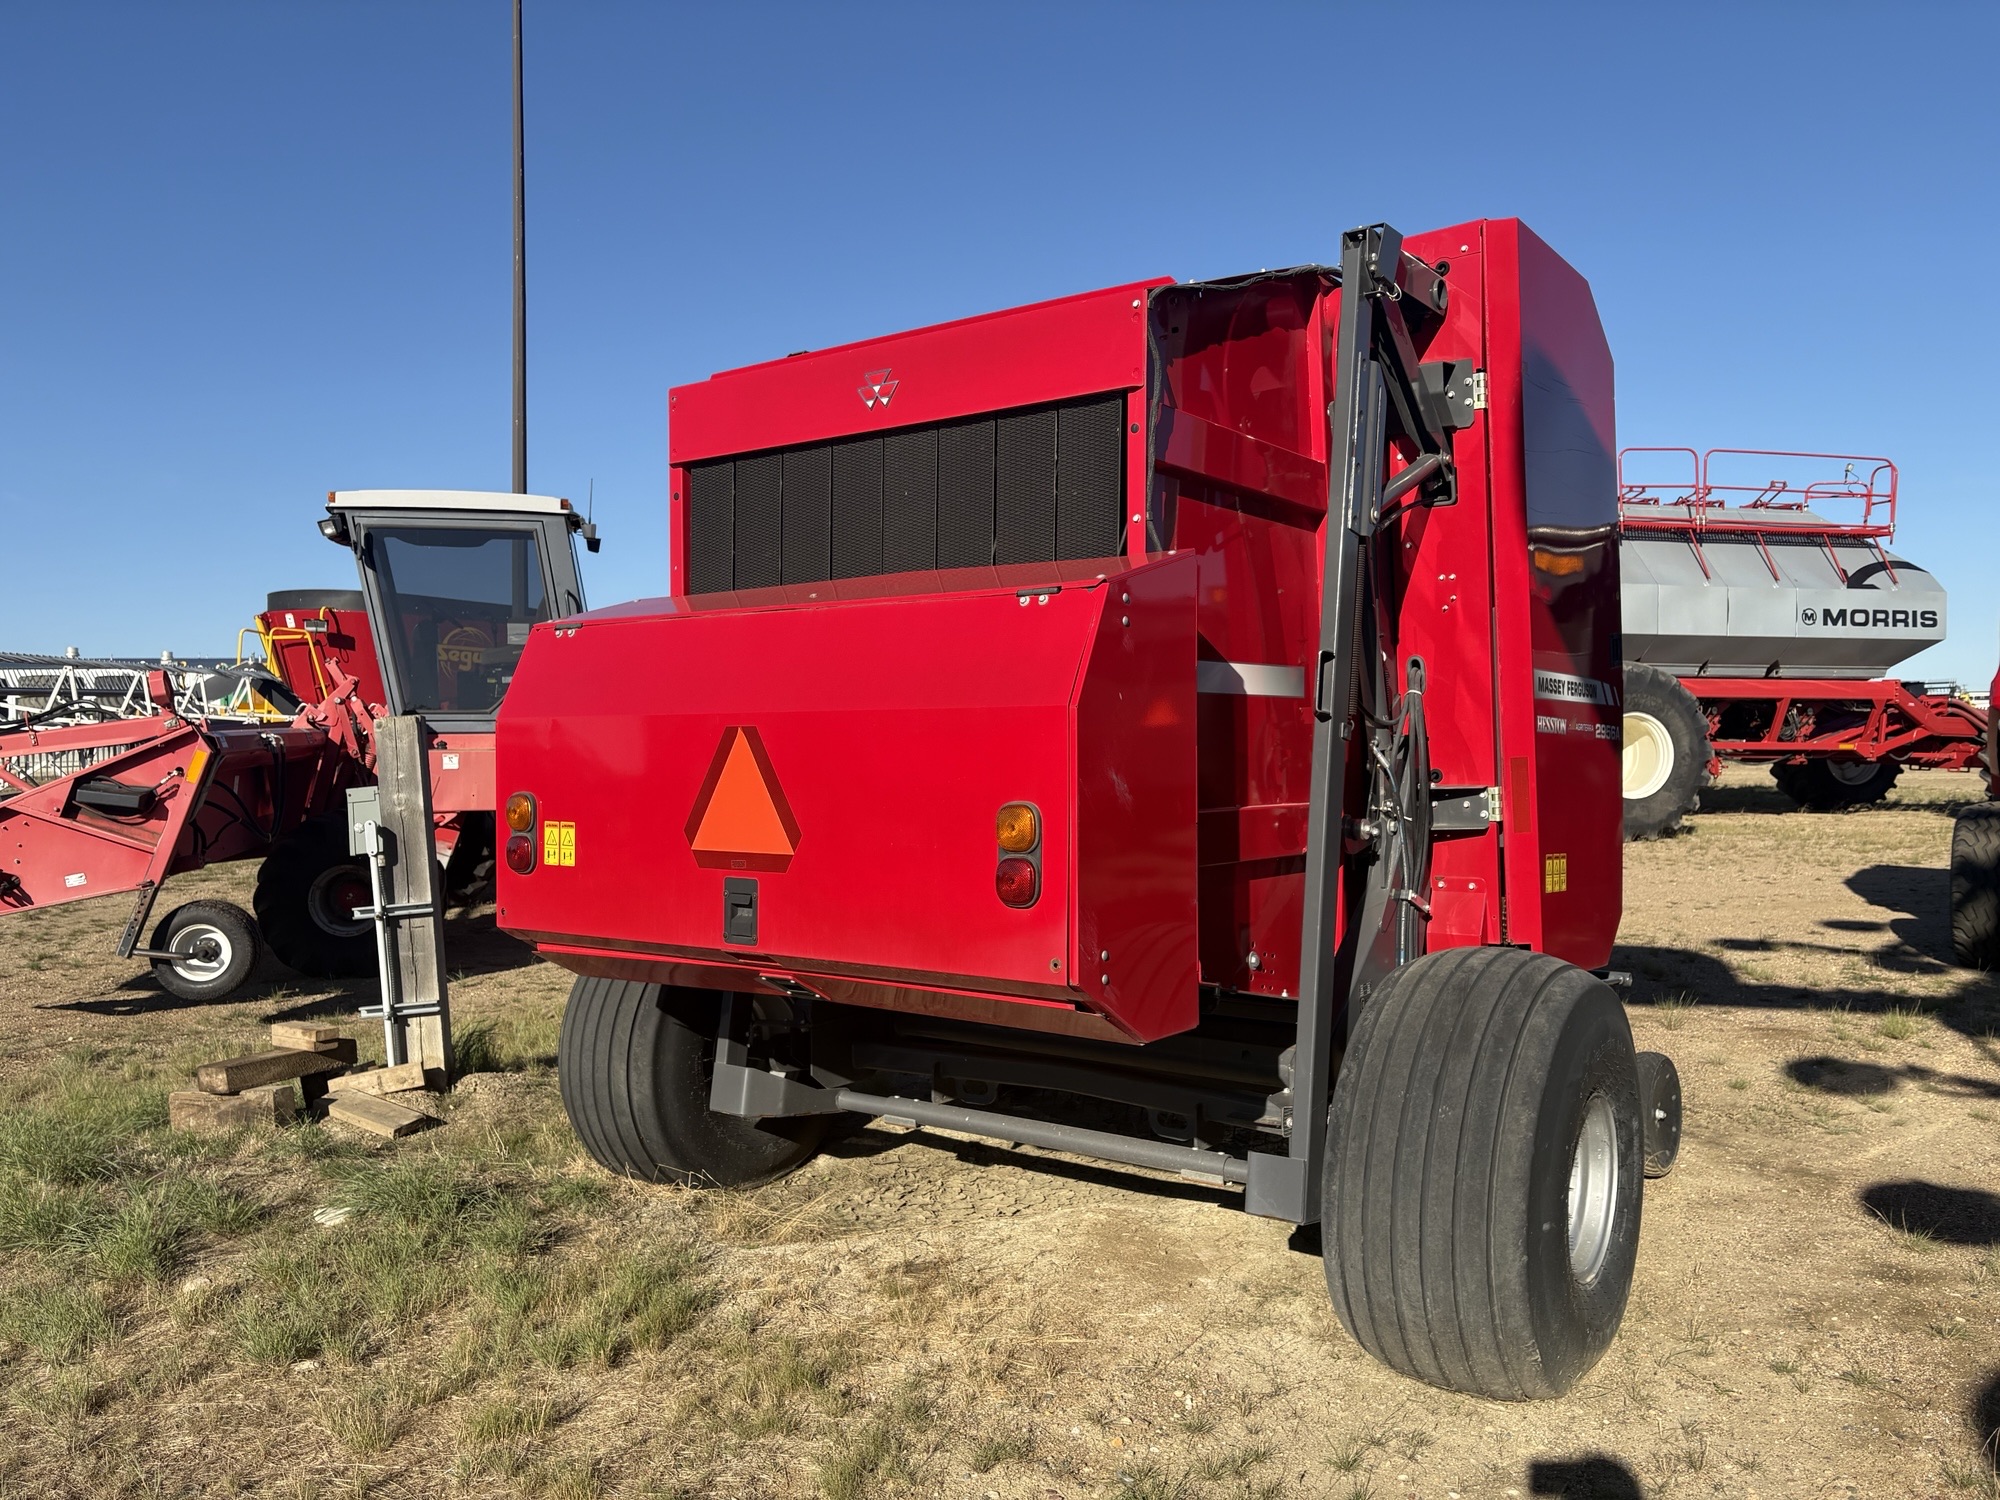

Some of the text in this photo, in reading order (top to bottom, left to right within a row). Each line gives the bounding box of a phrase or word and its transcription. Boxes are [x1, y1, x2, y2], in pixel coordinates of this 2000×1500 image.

[1822, 608, 1938, 628] MORRIS
[437, 644, 481, 672] Segu
[1537, 677, 1598, 699] MASSEY FERGUSON
[1536, 715, 1567, 735] HESSTON
[1595, 723, 1621, 740] 2956A
